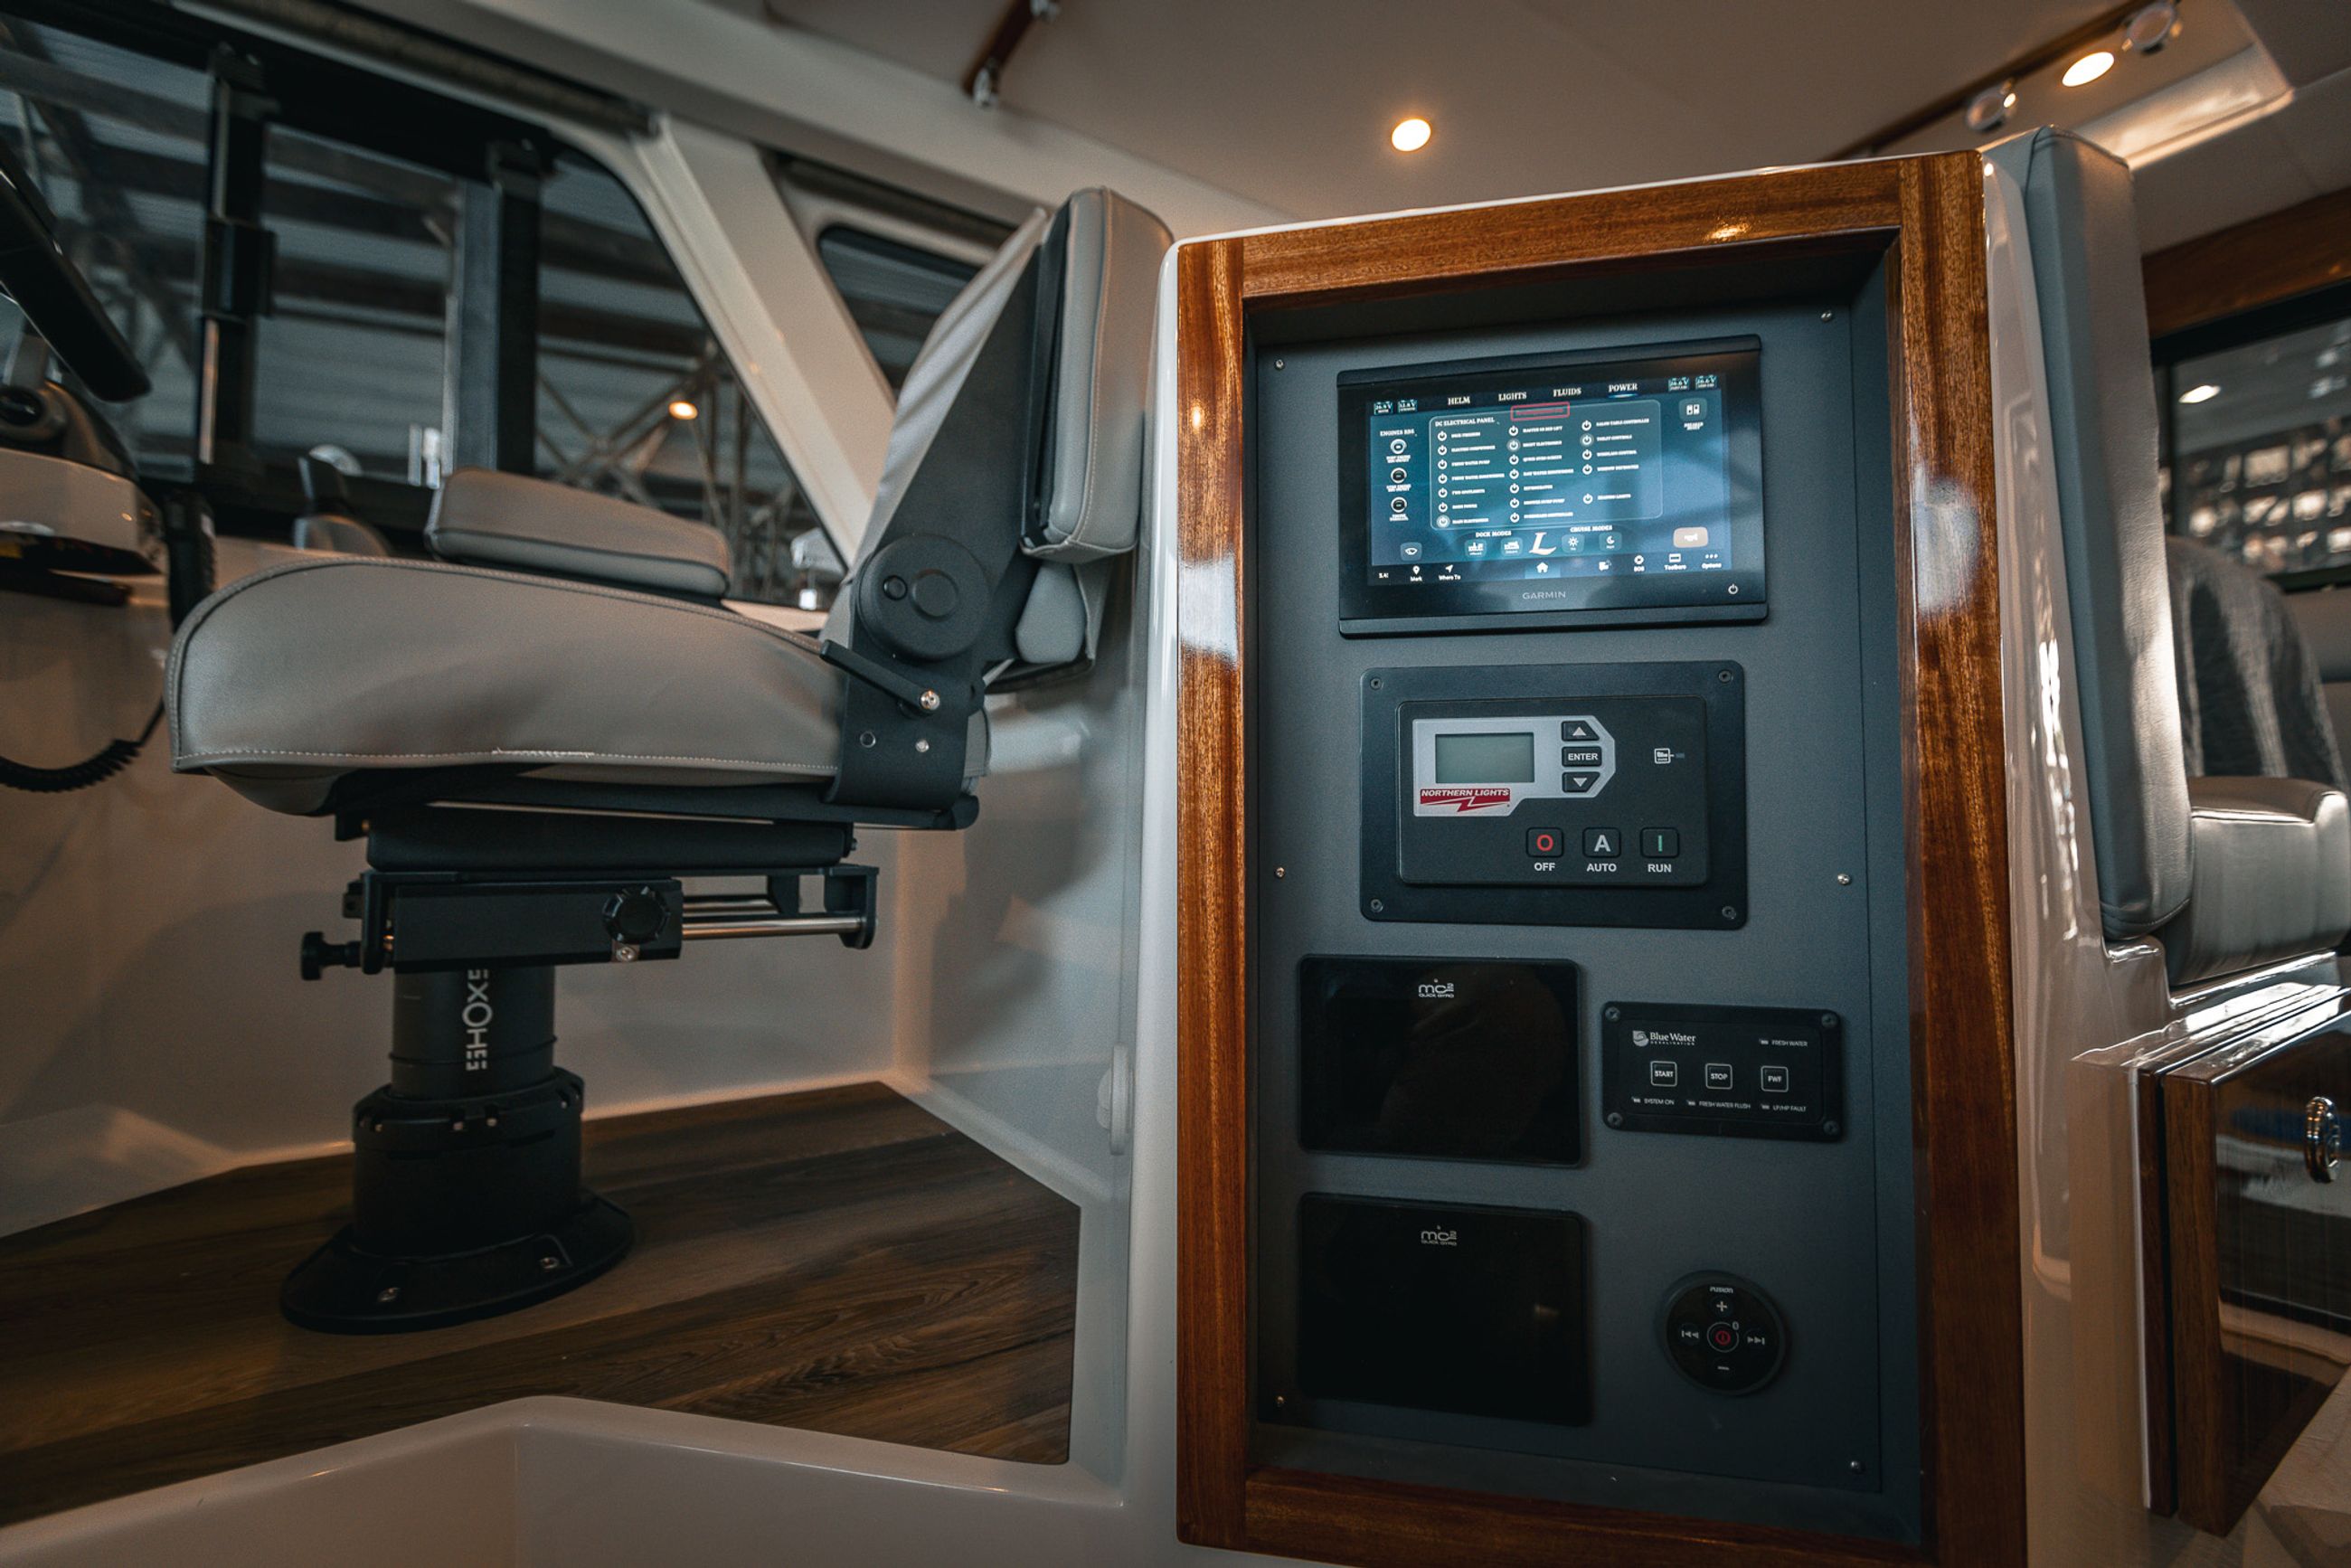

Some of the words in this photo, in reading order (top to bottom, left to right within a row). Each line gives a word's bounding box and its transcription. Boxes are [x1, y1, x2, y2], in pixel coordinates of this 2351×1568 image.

[1553, 387, 1581, 397] FLUIDS
[1608, 383, 1638, 392] POWER
[1448, 396, 1471, 406] HELM
[1498, 392, 1527, 401] LIGHTS
[1443, 419, 1476, 427] ELECTRICAL
[1522, 590, 1566, 600] GARMIN
[1567, 751, 1599, 761] ENTER
[1474, 789, 1510, 797] LIGHTS
[1593, 835, 1611, 853] A
[1534, 862, 1555, 872] OFF
[1586, 863, 1617, 874] AUTO
[1648, 863, 1672, 874] RUN
[1649, 1031, 1669, 1041] Blue
[1669, 1033, 1696, 1043] Water
[1710, 1072, 1728, 1081] STOP
[1699, 1100, 1716, 1108] FRESH
[1717, 1100, 1734, 1109] WATER
